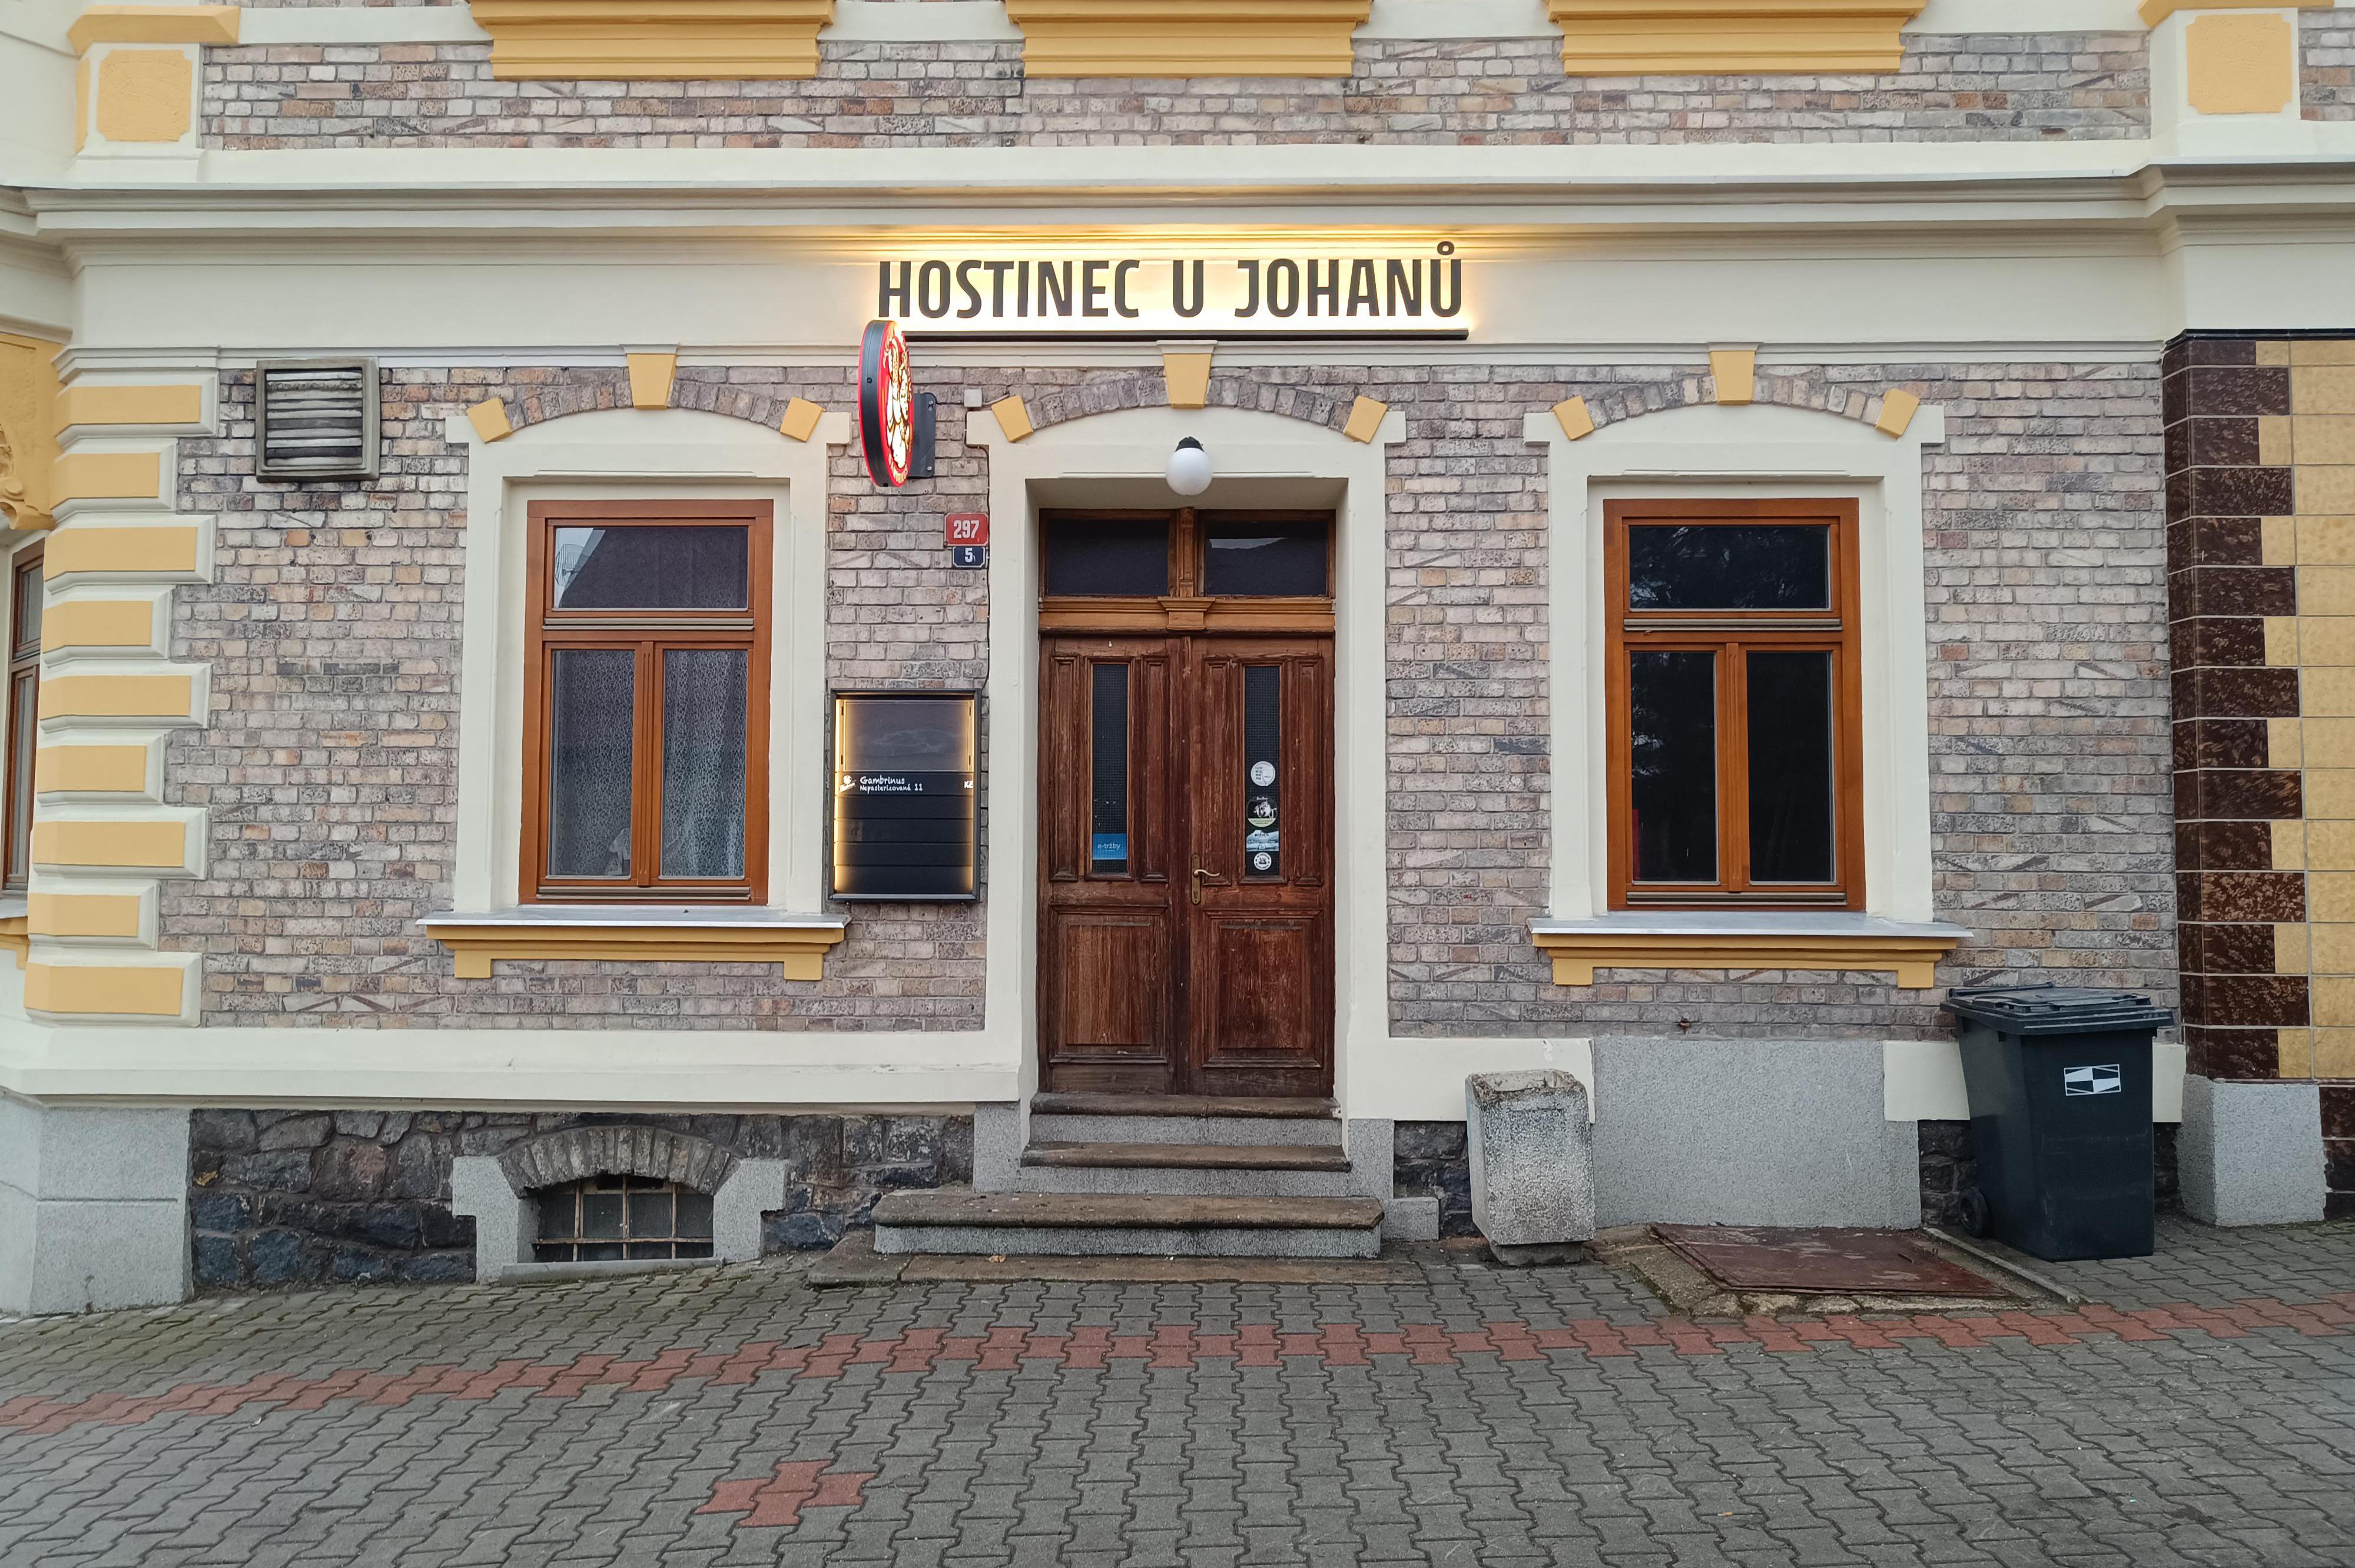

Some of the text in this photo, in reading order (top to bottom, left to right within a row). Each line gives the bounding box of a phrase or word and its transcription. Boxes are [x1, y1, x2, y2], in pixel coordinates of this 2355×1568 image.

[878, 240, 1462, 319] HOSTINEC U JOHANŮ
[953, 520, 980, 539] 297
[964, 548, 973, 563] 5
[860, 774, 905, 785] Gambrinus
